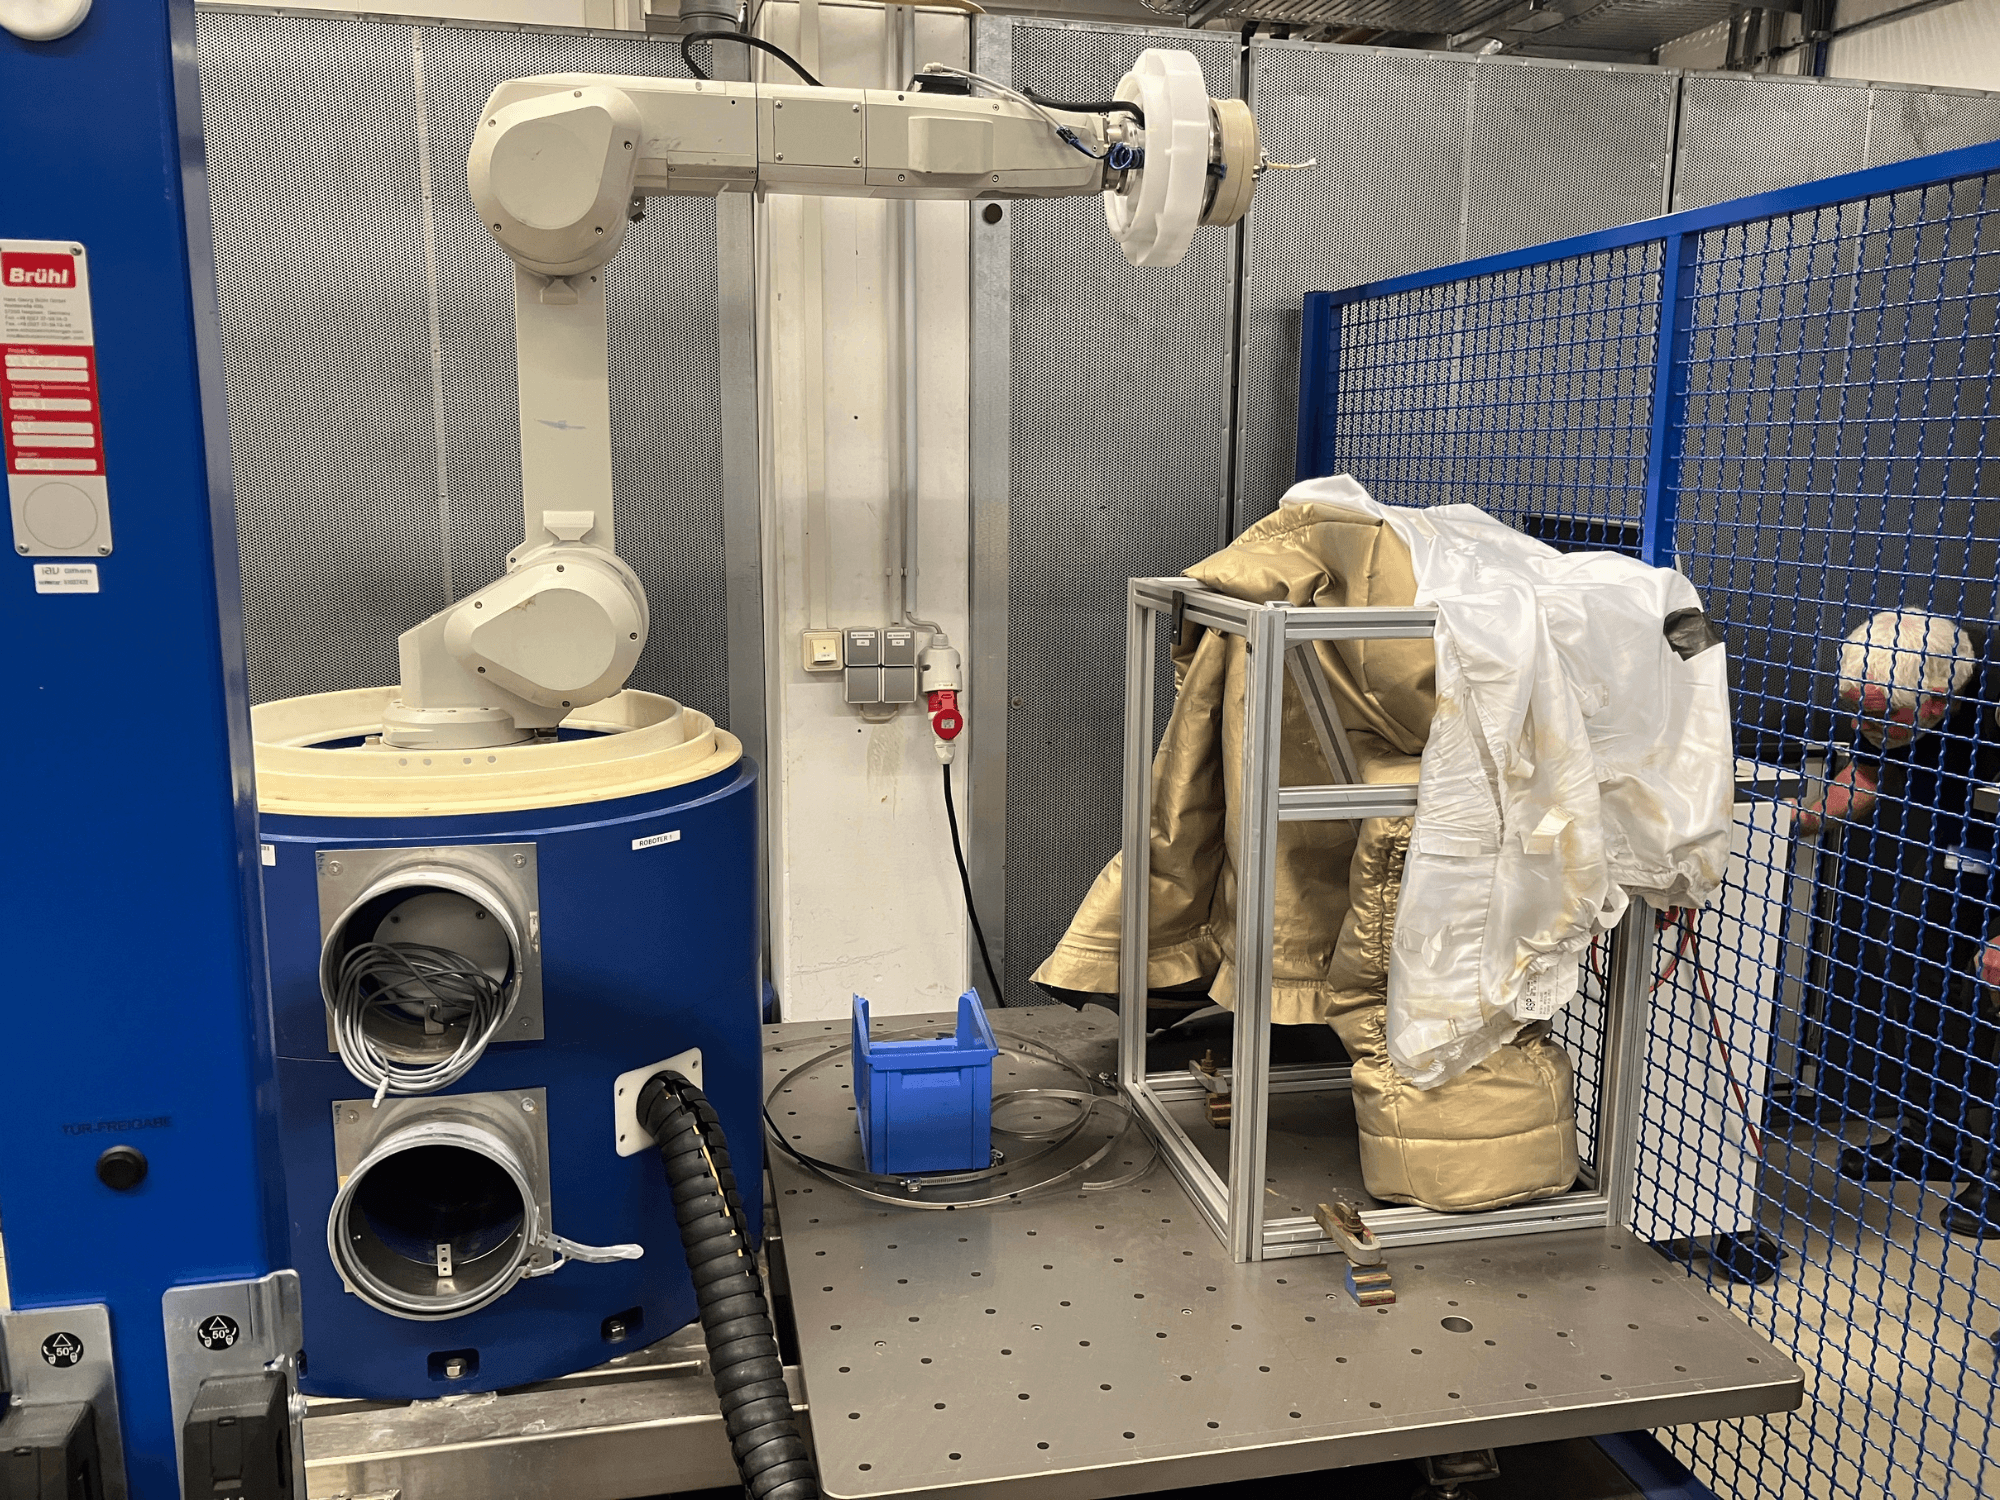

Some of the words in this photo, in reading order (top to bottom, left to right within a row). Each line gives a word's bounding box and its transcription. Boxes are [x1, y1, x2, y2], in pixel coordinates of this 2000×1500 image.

[9, 267, 69, 285] Brühl
[639, 834, 668, 847] ROBOTER
[1526, 998, 1536, 1012] ASP
